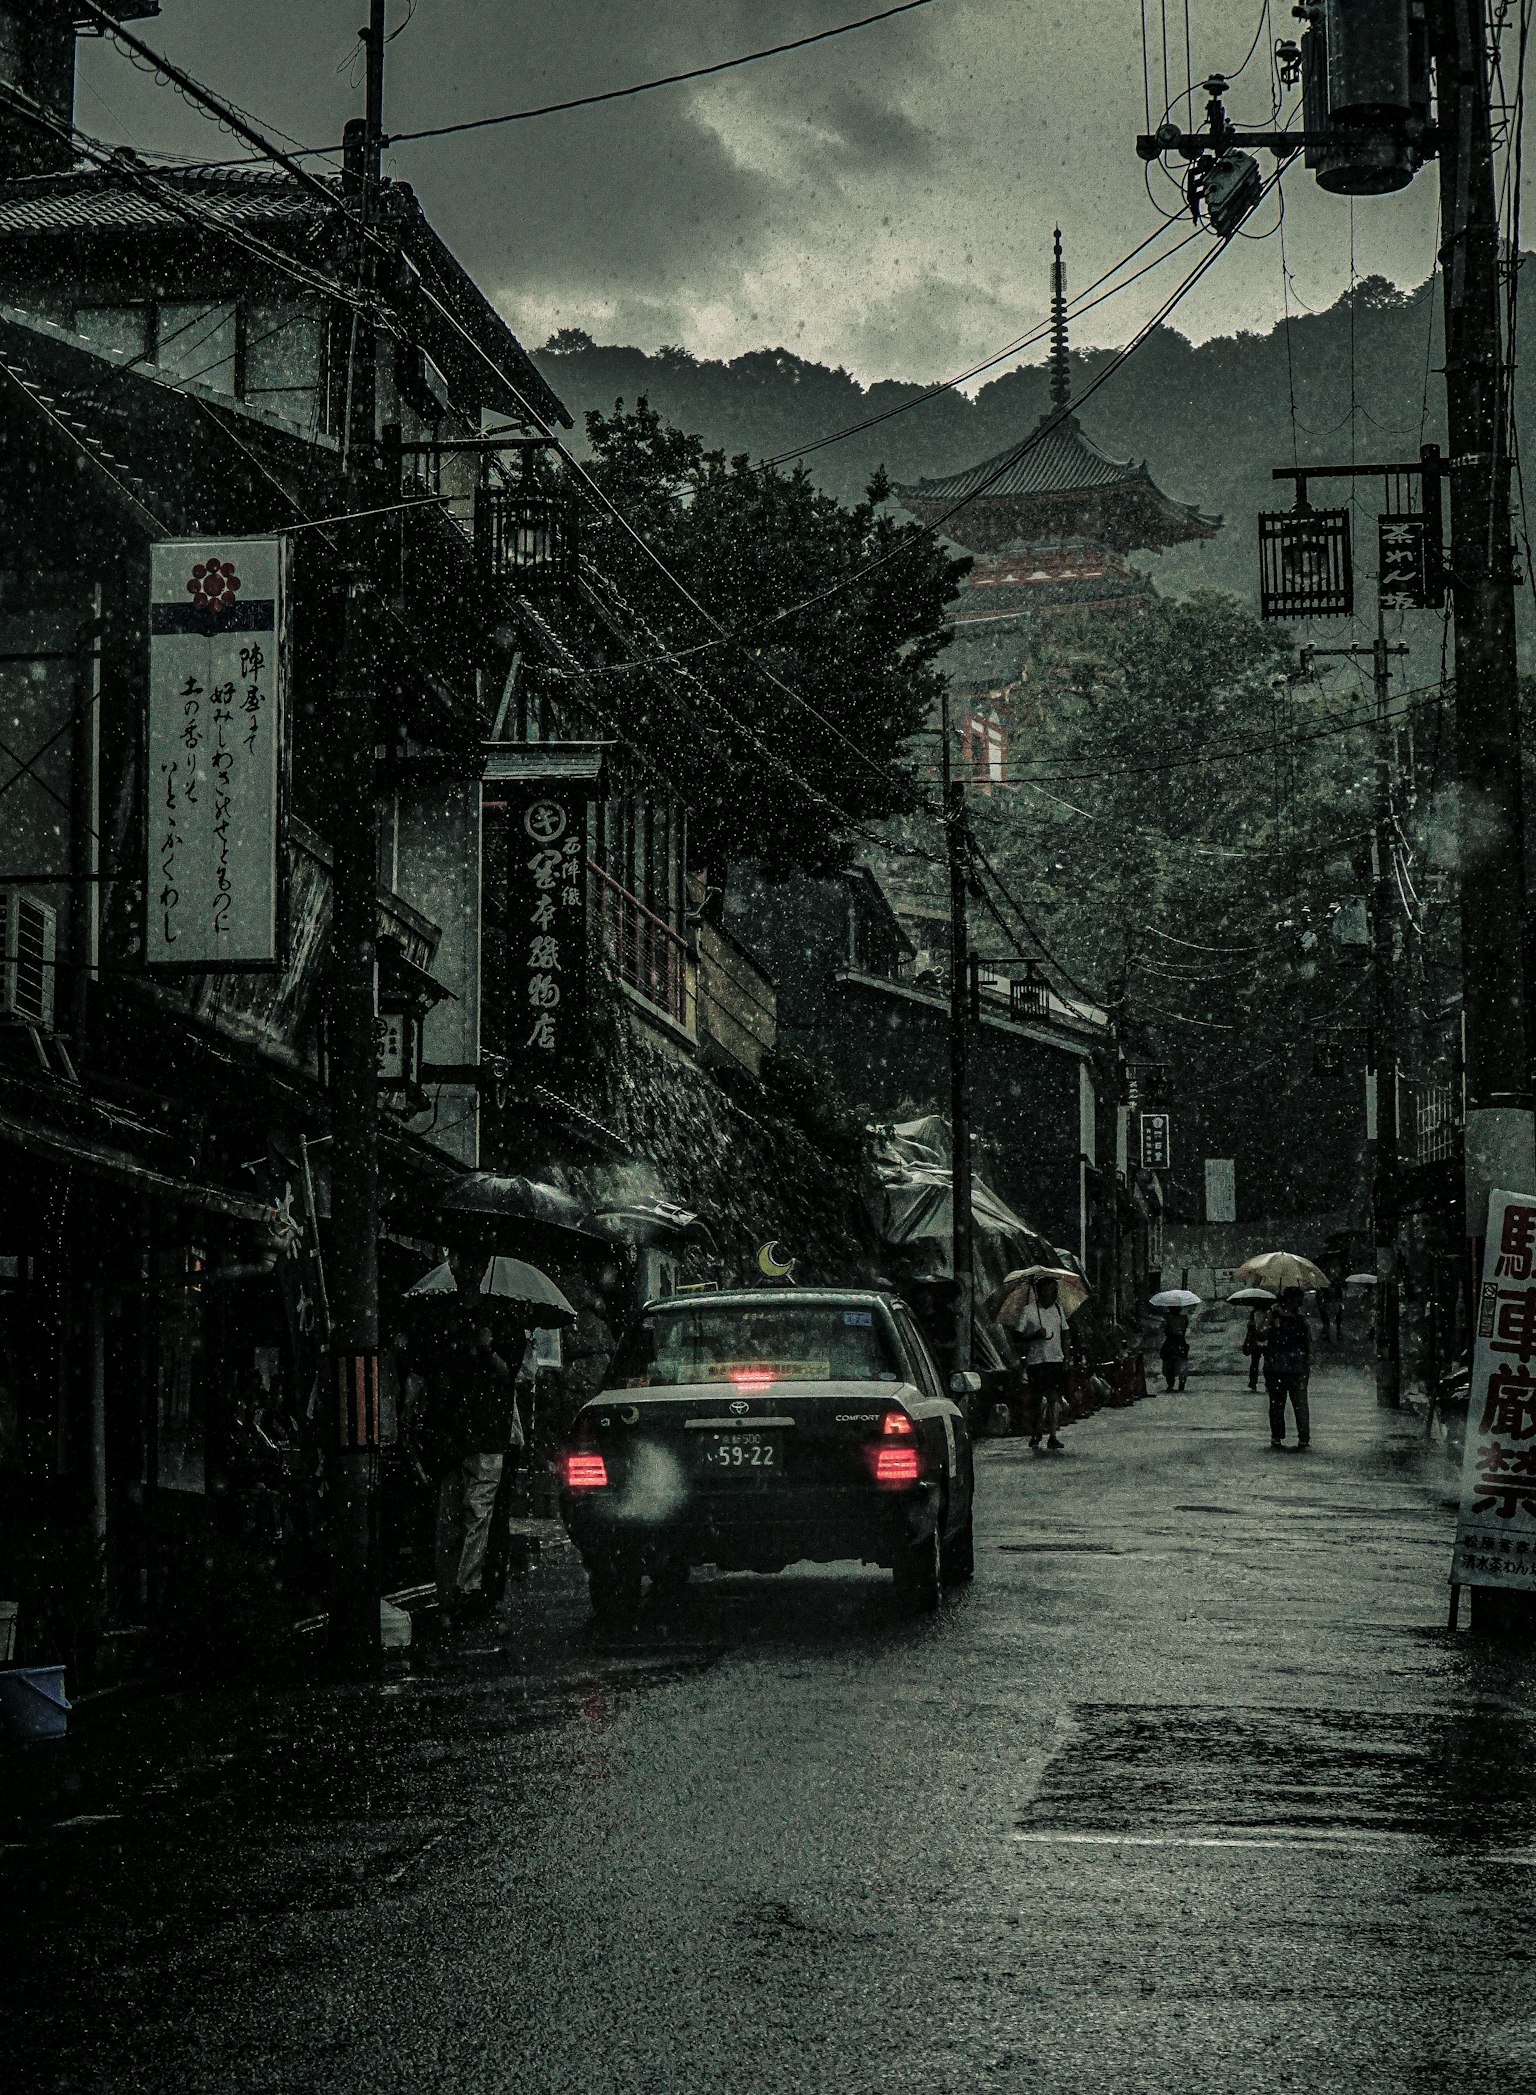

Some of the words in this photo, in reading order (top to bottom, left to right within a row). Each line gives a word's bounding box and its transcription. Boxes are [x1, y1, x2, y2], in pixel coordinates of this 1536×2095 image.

[561, 837, 582, 907] 西陣織
[835, 1414, 880, 1422] COMFORT
[719, 1446, 774, 1466] 59-22
